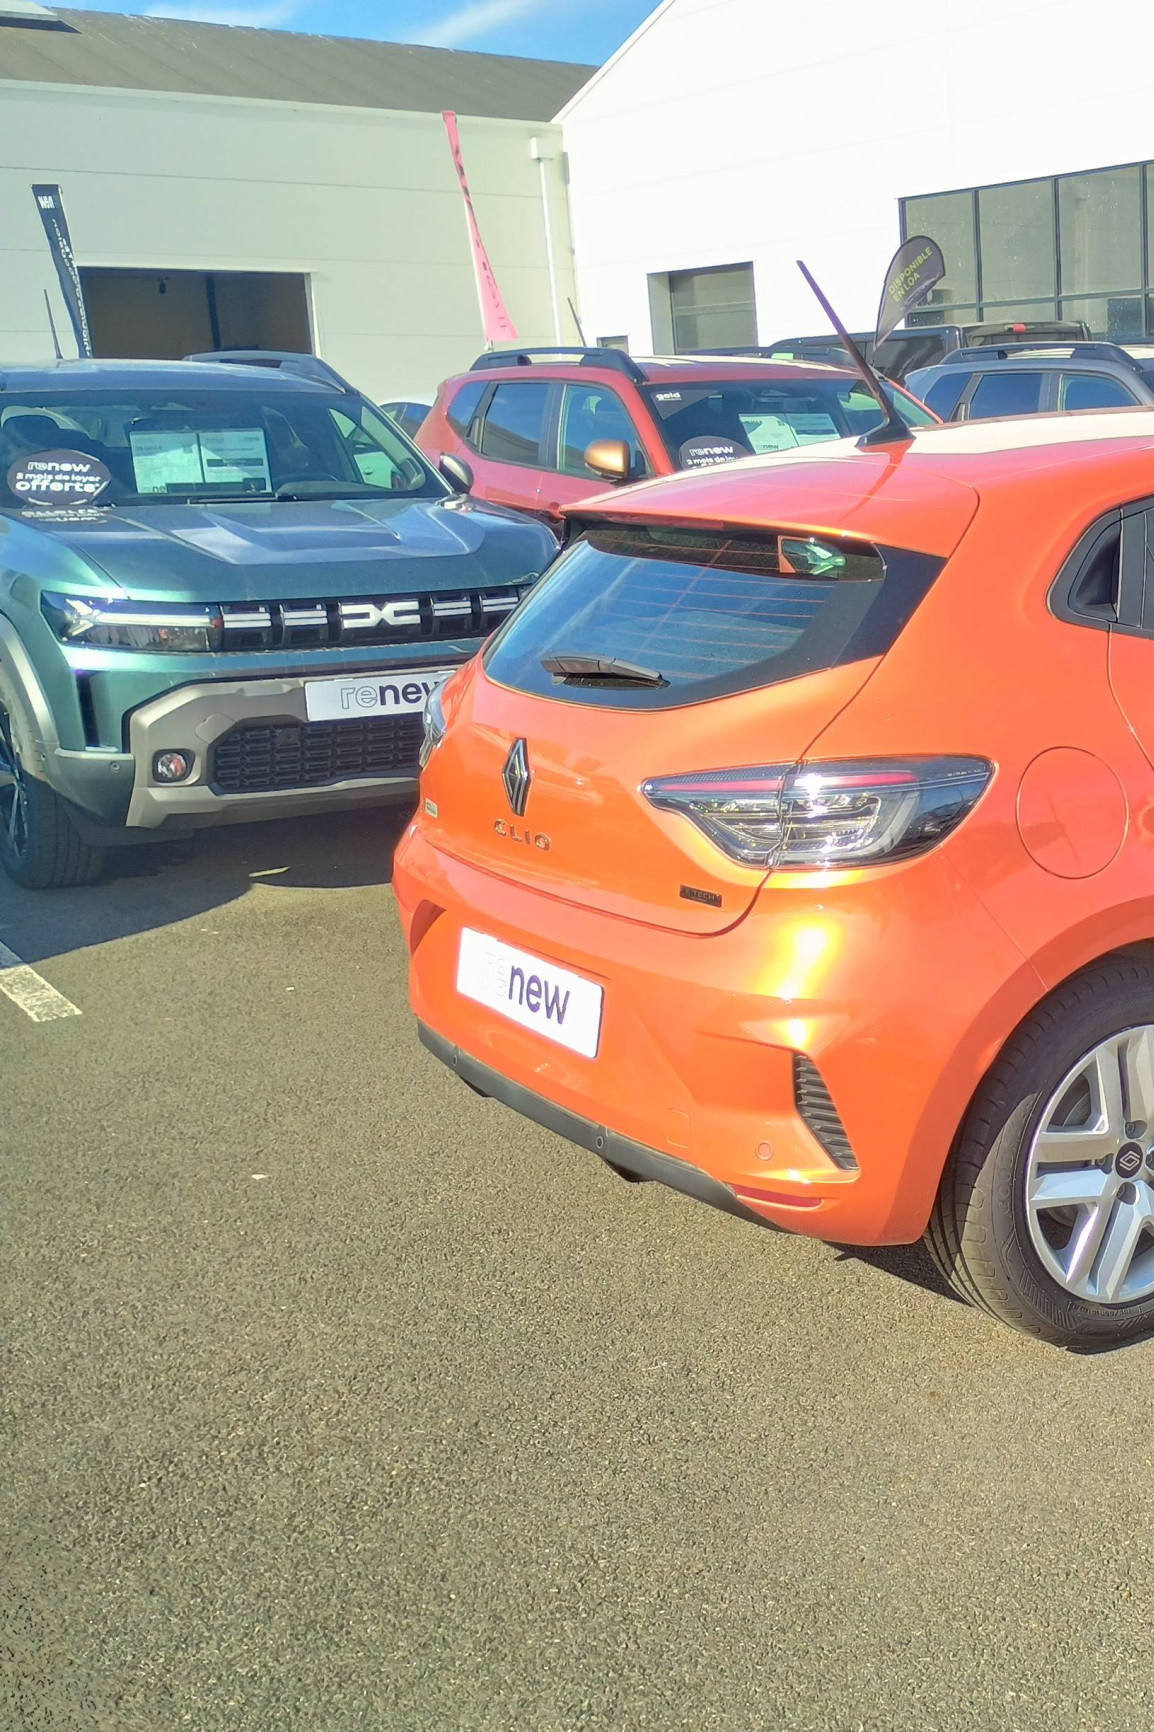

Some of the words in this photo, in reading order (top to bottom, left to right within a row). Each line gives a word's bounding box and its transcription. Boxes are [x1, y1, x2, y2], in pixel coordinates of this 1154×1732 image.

[888, 246, 933, 295] DISPONIBLE
[892, 288, 906, 302] EN
[903, 272, 920, 290] LOA
[689, 446, 734, 457] renew
[25, 472, 53, 480] mois
[54, 473, 70, 481] de
[71, 474, 101, 482] loyer
[27, 461, 91, 473] renew
[494, 818, 552, 851] CLIO
